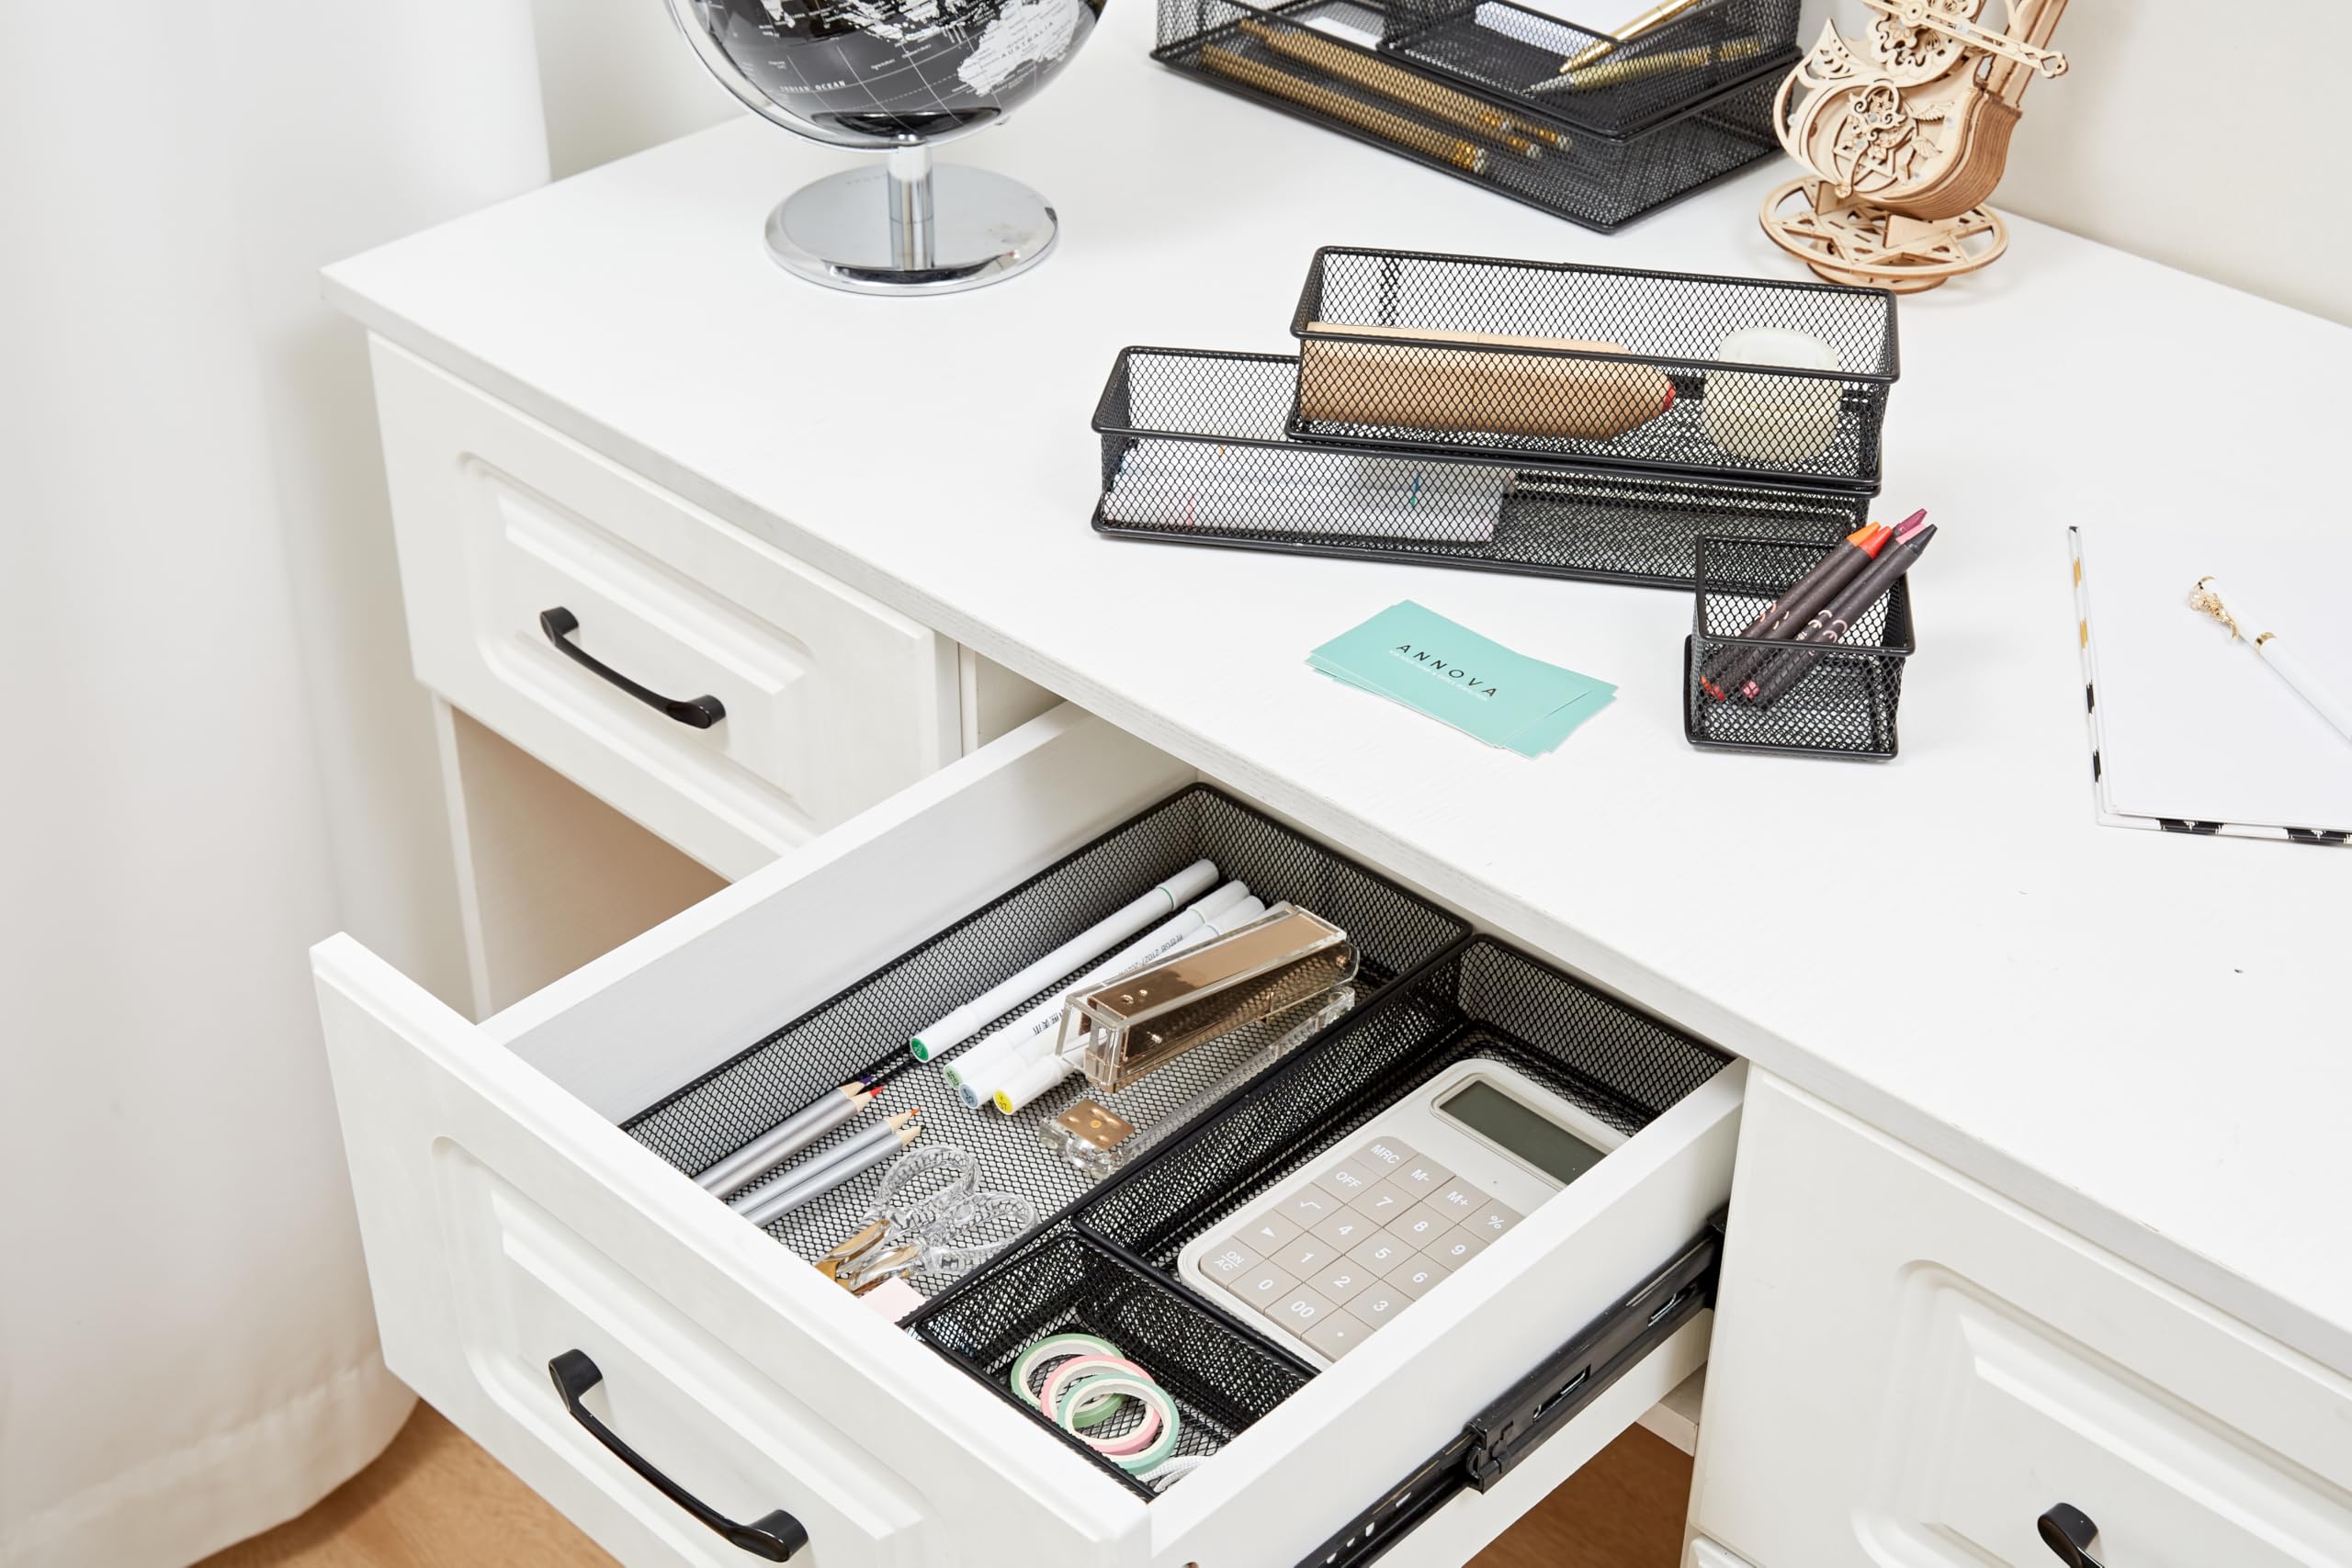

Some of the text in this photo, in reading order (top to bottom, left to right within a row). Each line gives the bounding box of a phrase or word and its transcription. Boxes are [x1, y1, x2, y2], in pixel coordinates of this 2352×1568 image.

[815, 80, 846, 92] OCEAN
[1395, 644, 1498, 698] ANNOVA
[1370, 1143, 1400, 1165] MRC
[1335, 1171, 1362, 1189] OFF
[1375, 1197, 1393, 1207] 7
[1446, 1190, 1469, 1207] M+
[1413, 1221, 1429, 1233] 8
[1487, 1215, 1503, 1230] %
[1339, 1224, 1353, 1235] 4
[1374, 1247, 1391, 1259] 5
[1451, 1245, 1467, 1257] 9
[1227, 1251, 1245, 1265] ON
[1300, 1252, 1315, 1263] 1
[1213, 1259, 1233, 1271] AC
[1334, 1276, 1351, 1288] 2
[1412, 1271, 1429, 1284] 6
[1258, 1279, 1273, 1291] 0
[1291, 1301, 1316, 1318] 00
[1373, 1300, 1389, 1312] 3
